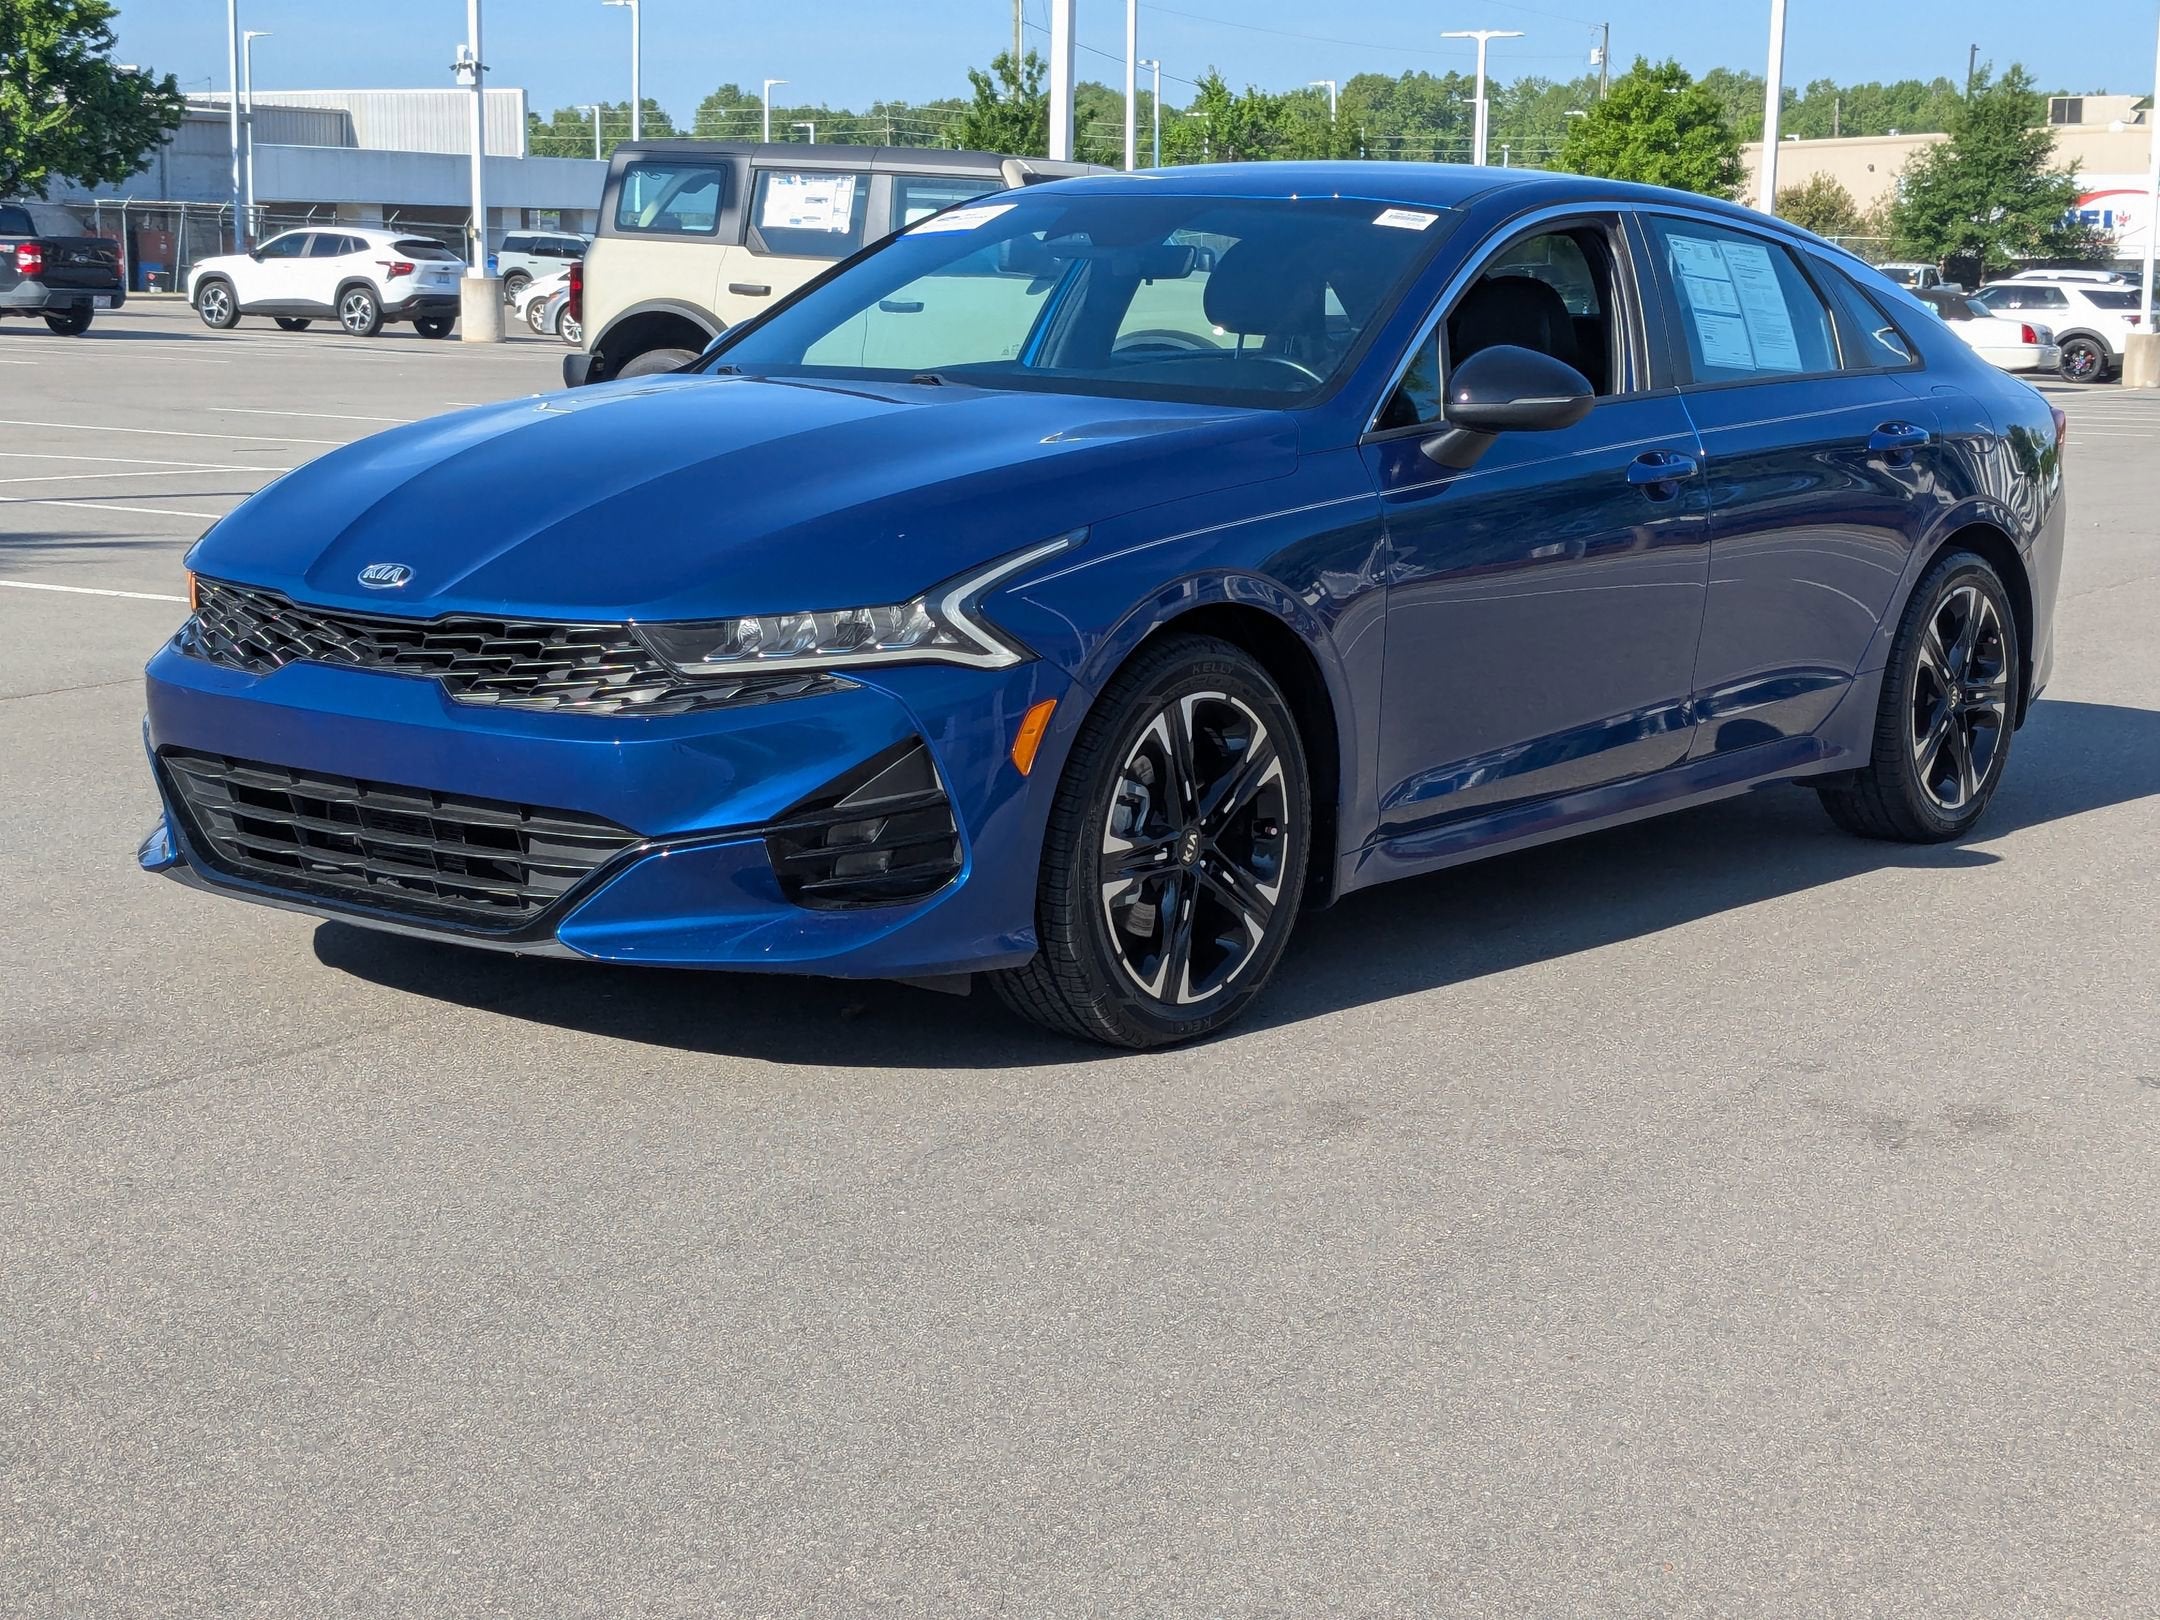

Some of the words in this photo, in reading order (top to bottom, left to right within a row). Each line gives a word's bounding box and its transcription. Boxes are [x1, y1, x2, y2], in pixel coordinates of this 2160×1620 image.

[362, 565, 404, 583] KIA
[1192, 661, 1234, 675] KELLY
[1182, 834, 1197, 862] KIA
